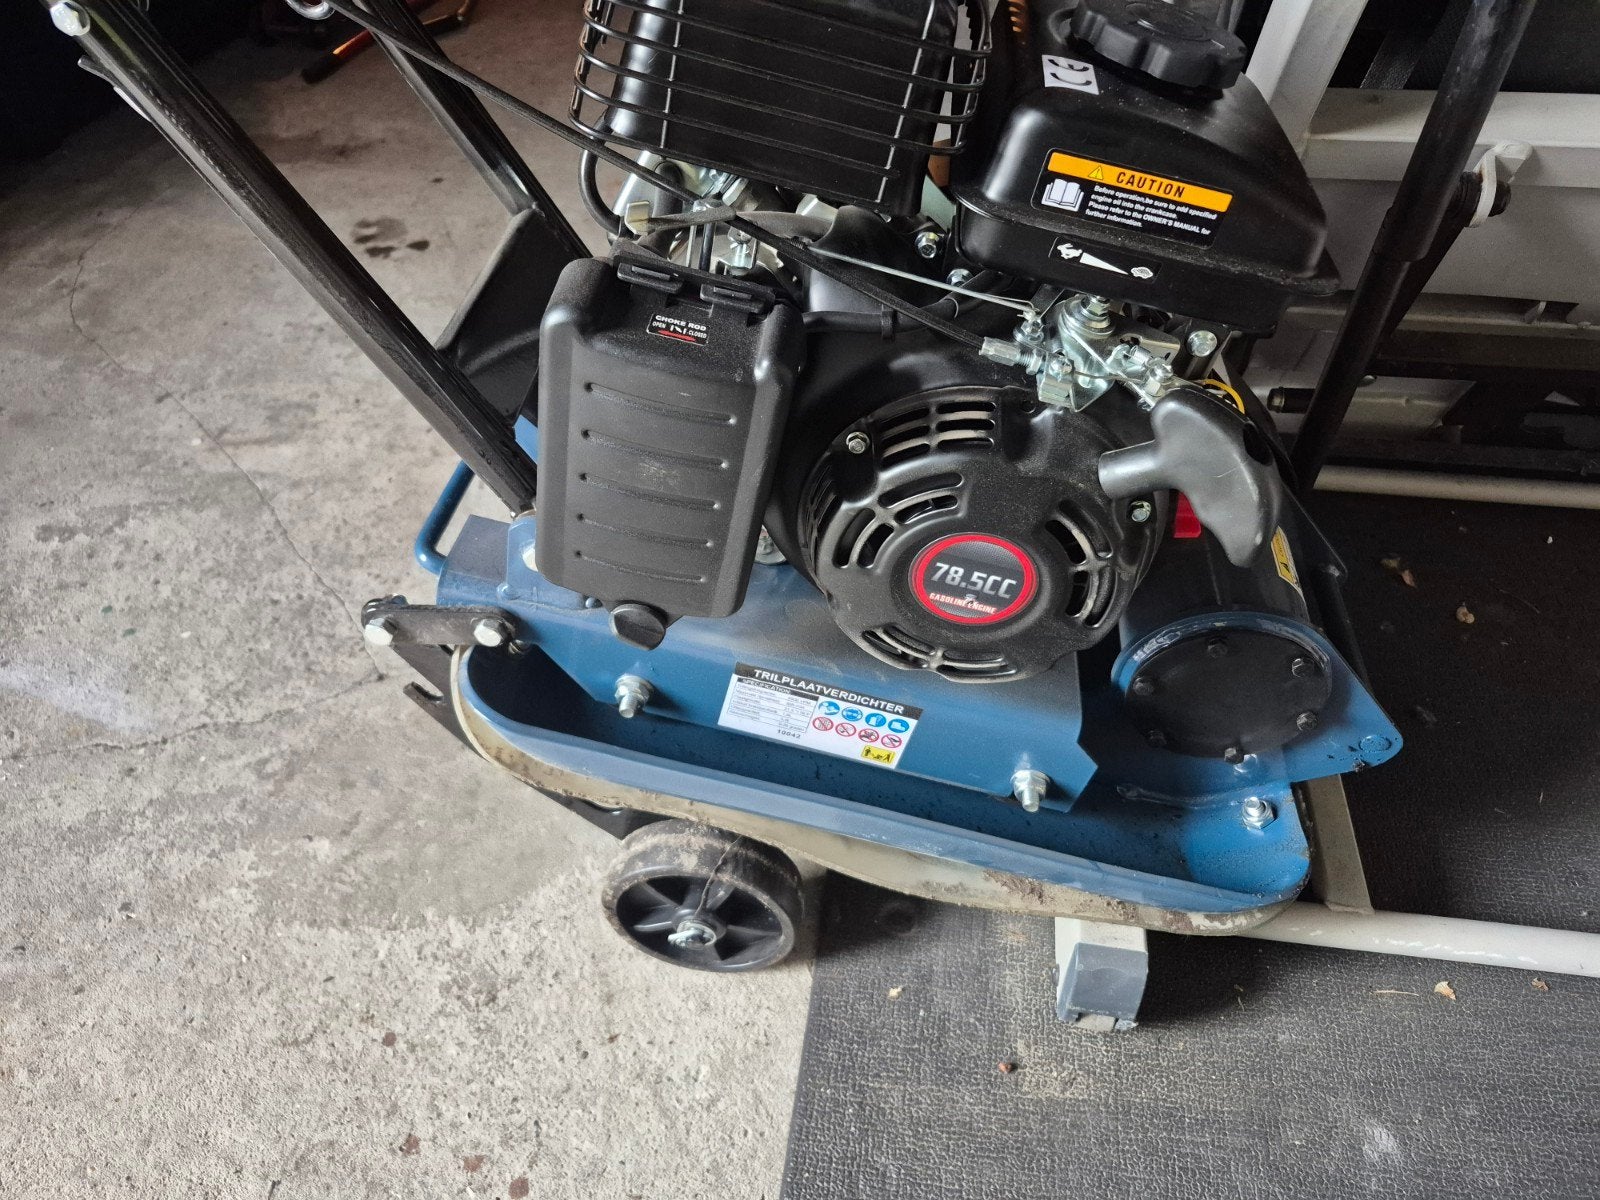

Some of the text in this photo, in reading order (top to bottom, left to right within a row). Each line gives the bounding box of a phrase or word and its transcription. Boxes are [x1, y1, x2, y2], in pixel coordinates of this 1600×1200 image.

[1116, 171, 1186, 198] CAUTION
[1091, 194, 1112, 203] engine
[1121, 200, 1134, 208] into
[1134, 203, 1145, 211] the
[1094, 184, 1115, 196] Before
[1153, 199, 1169, 208] sure
[1176, 205, 1190, 214] add
[1189, 208, 1218, 220] specified
[1085, 208, 1143, 227] further information.
[1088, 200, 1109, 211] Please
[1109, 206, 1125, 214] refer
[1143, 213, 1173, 226] OWNER'S
[1173, 221, 1201, 233] MANUAL
[1200, 227, 1212, 235] for
[652, 321, 667, 329] OPEN
[655, 314, 707, 331] CHOKE ROD
[688, 330, 708, 339] CLOSED
[930, 562, 1018, 599] 78.5CC
[929, 592, 999, 615] GASOLINE ENGINE
[742, 679, 792, 694] SPECIFICATION
[754, 669, 905, 714] TRILPLAATVERDICHTER
